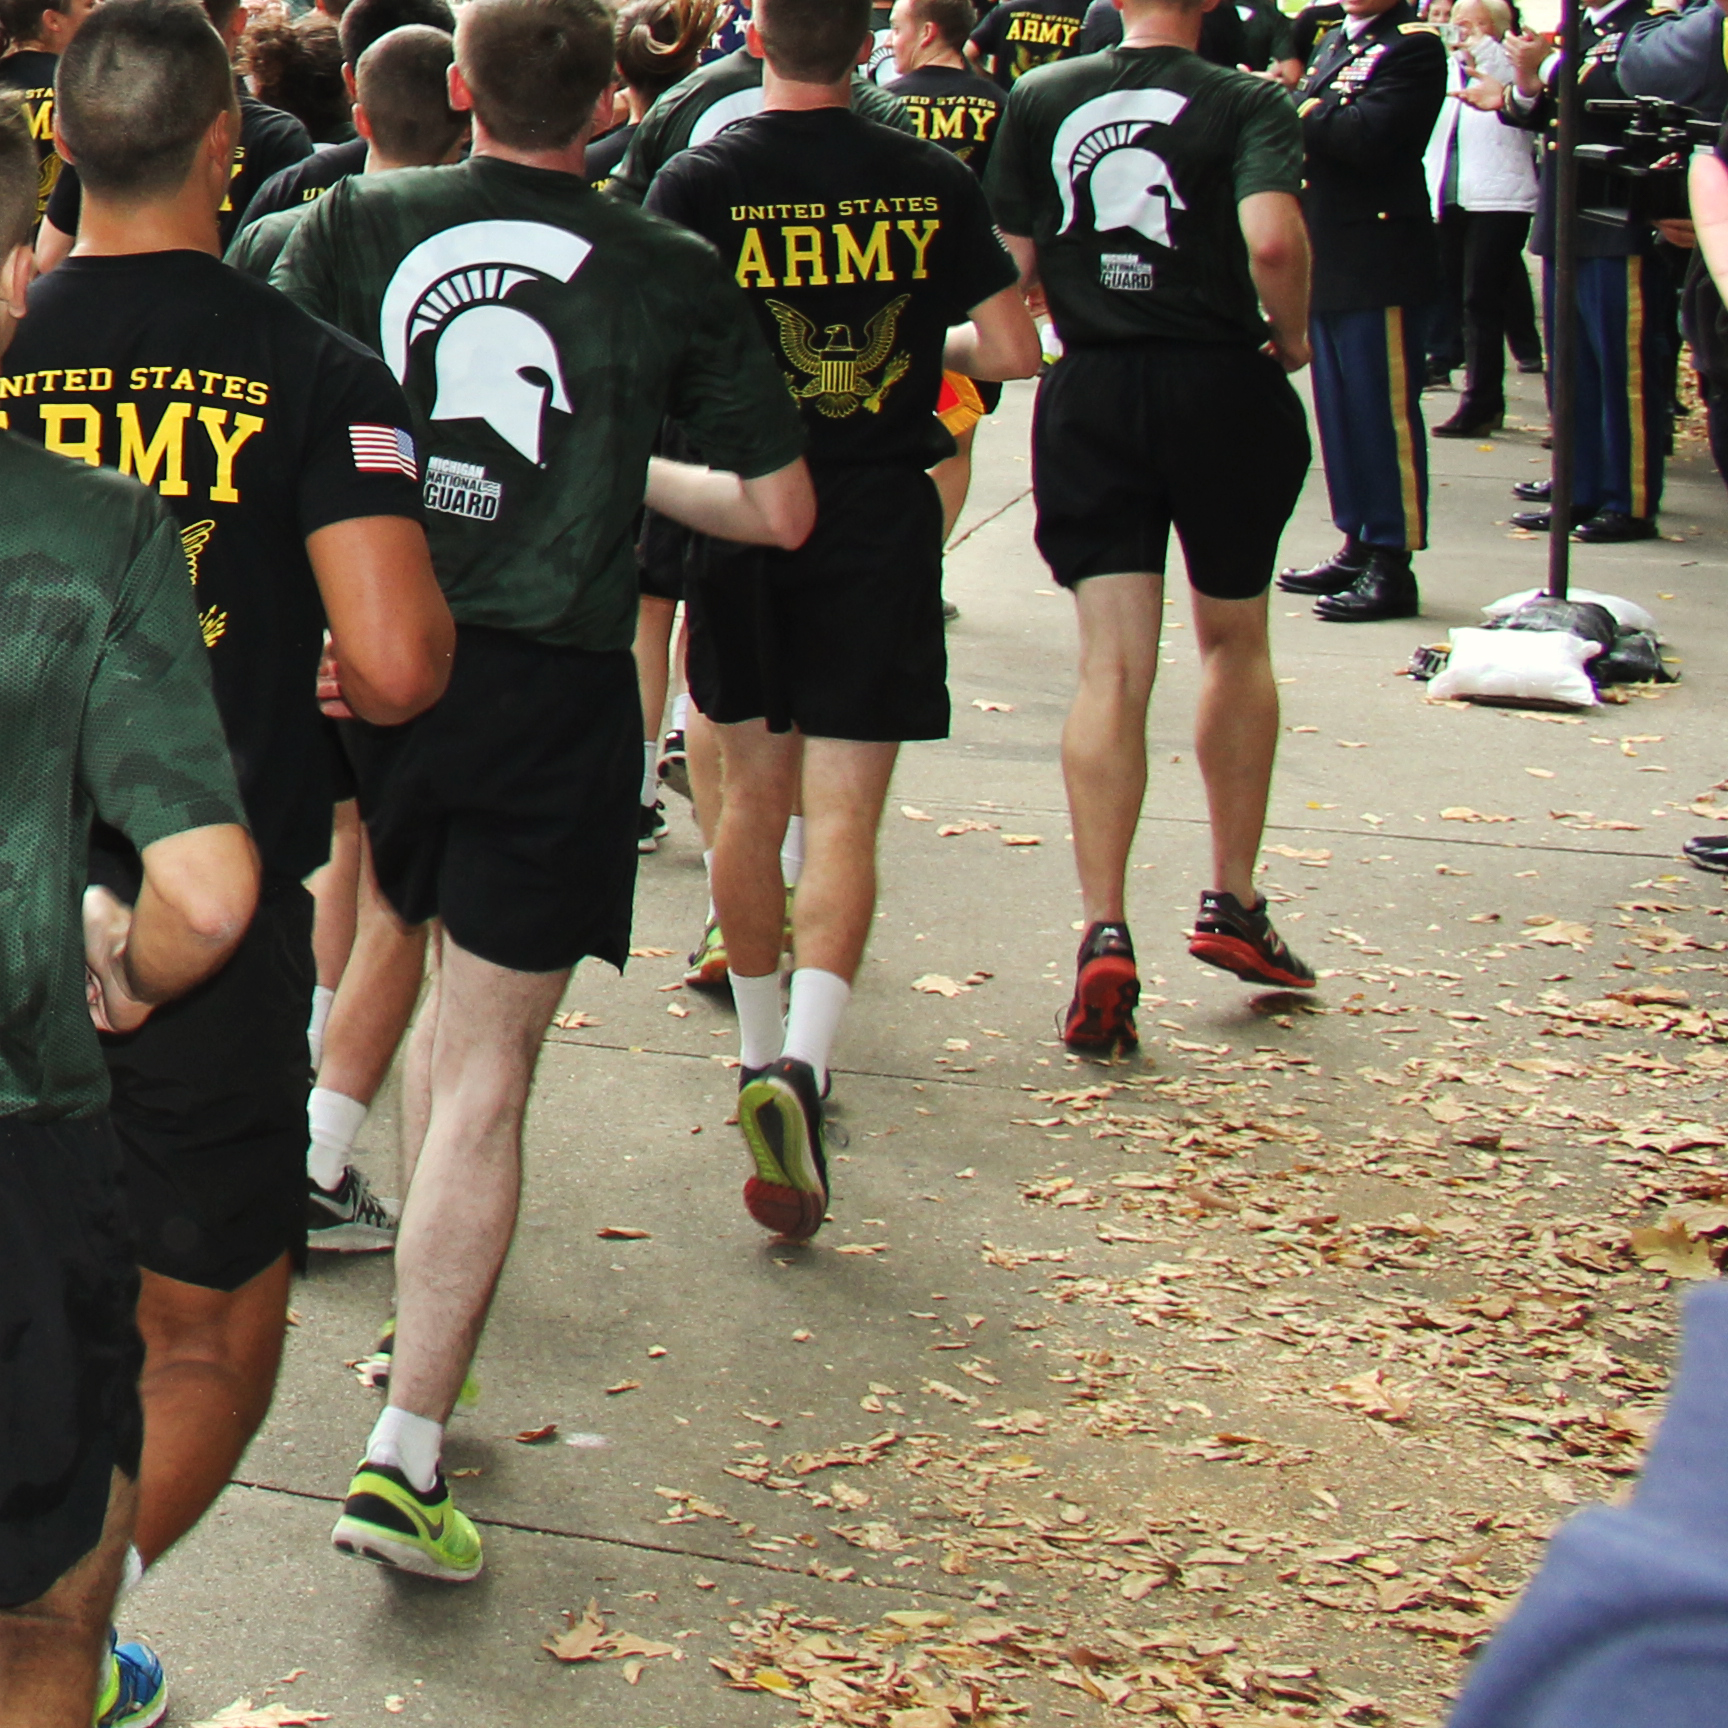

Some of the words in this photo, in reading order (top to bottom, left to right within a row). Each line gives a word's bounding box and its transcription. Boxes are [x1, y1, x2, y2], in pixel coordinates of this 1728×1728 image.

[1005, 18, 1079, 47] ARMY
[25, 87, 54, 99] STA
[901, 95, 931, 106] TED
[936, 96, 996, 109] STATES
[730, 203, 826, 221] UNITED
[838, 196, 939, 216] STATES
[734, 219, 940, 288] ARMY
[1101, 273, 1152, 289] GUARD
[129, 366, 269, 405] STATES
[428, 456, 485, 479] MICHIGAN
[426, 471, 482, 492] NATIONAL
[424, 483, 498, 520] GUARD
